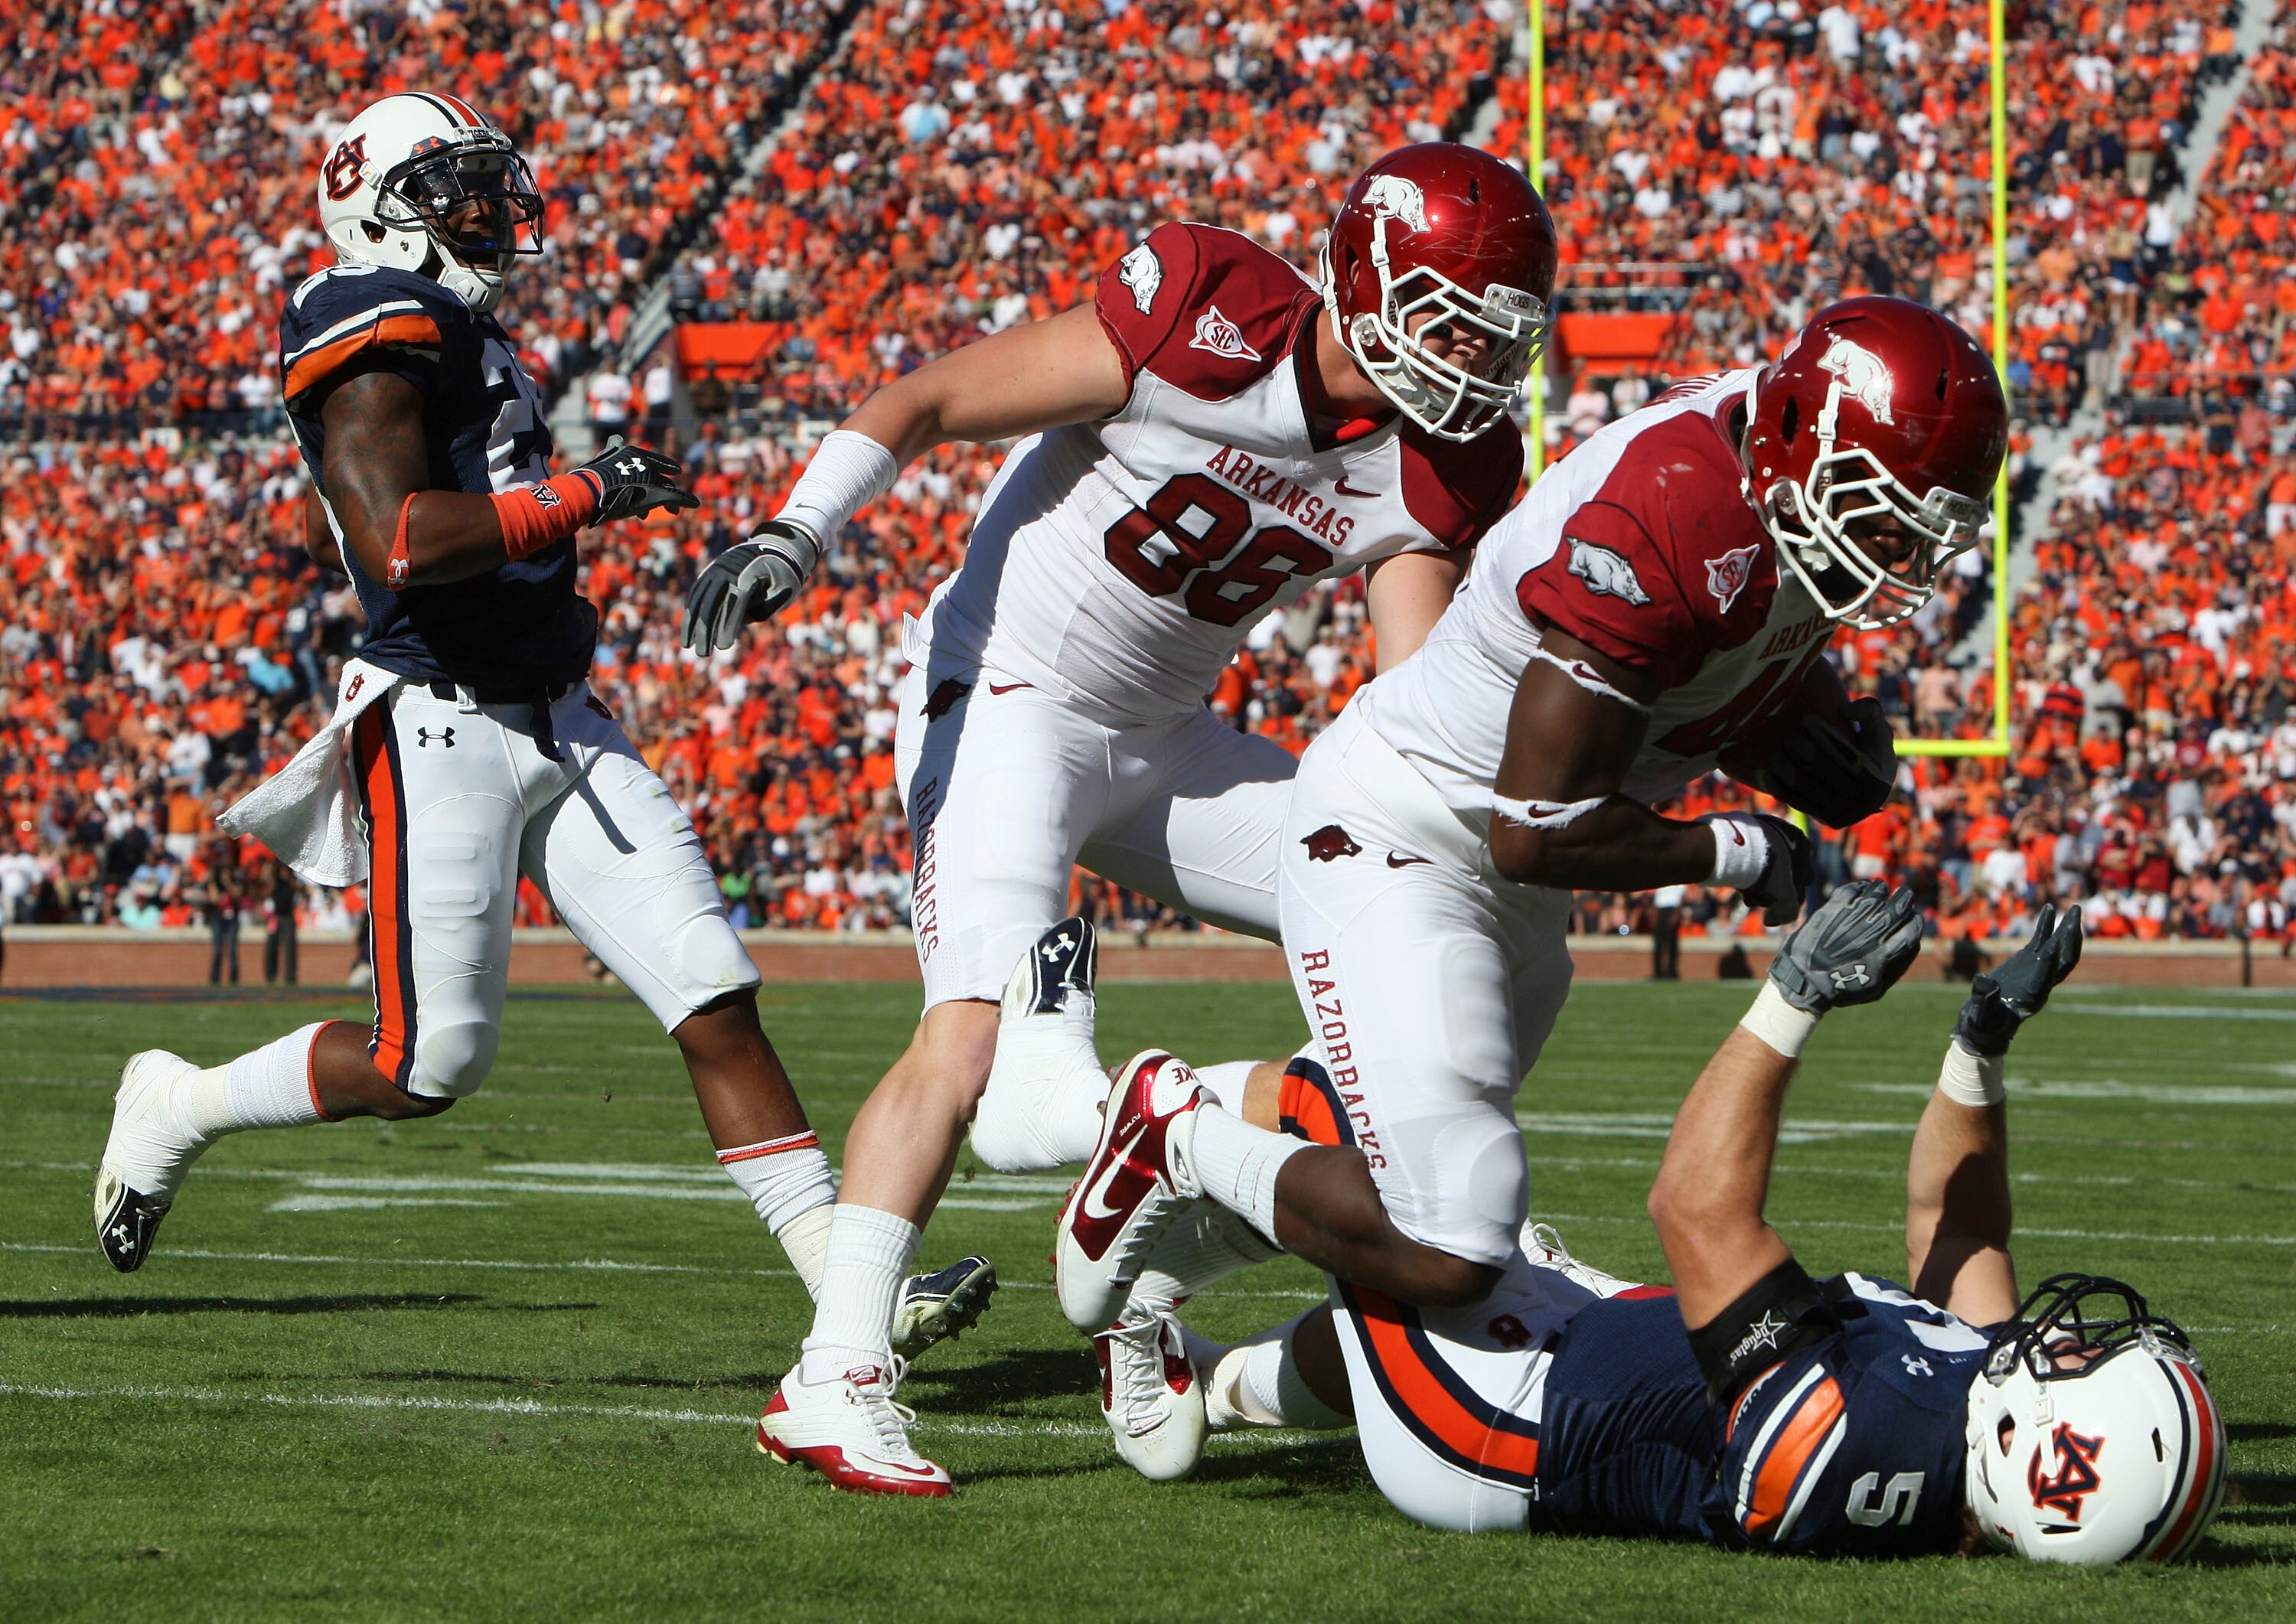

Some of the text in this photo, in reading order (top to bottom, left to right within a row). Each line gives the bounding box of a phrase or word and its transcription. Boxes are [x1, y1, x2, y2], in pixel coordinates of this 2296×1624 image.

[1506, 292, 1531, 309] HOGS
[1211, 325, 1234, 350] SEC
[1206, 444, 1354, 546] ARKANSAS
[1104, 471, 1334, 628] 86
[1301, 949, 1387, 1169] RAZORBACKS
[1730, 1325, 1771, 1362] Douglas
[1845, 1471, 1925, 1528] 5
